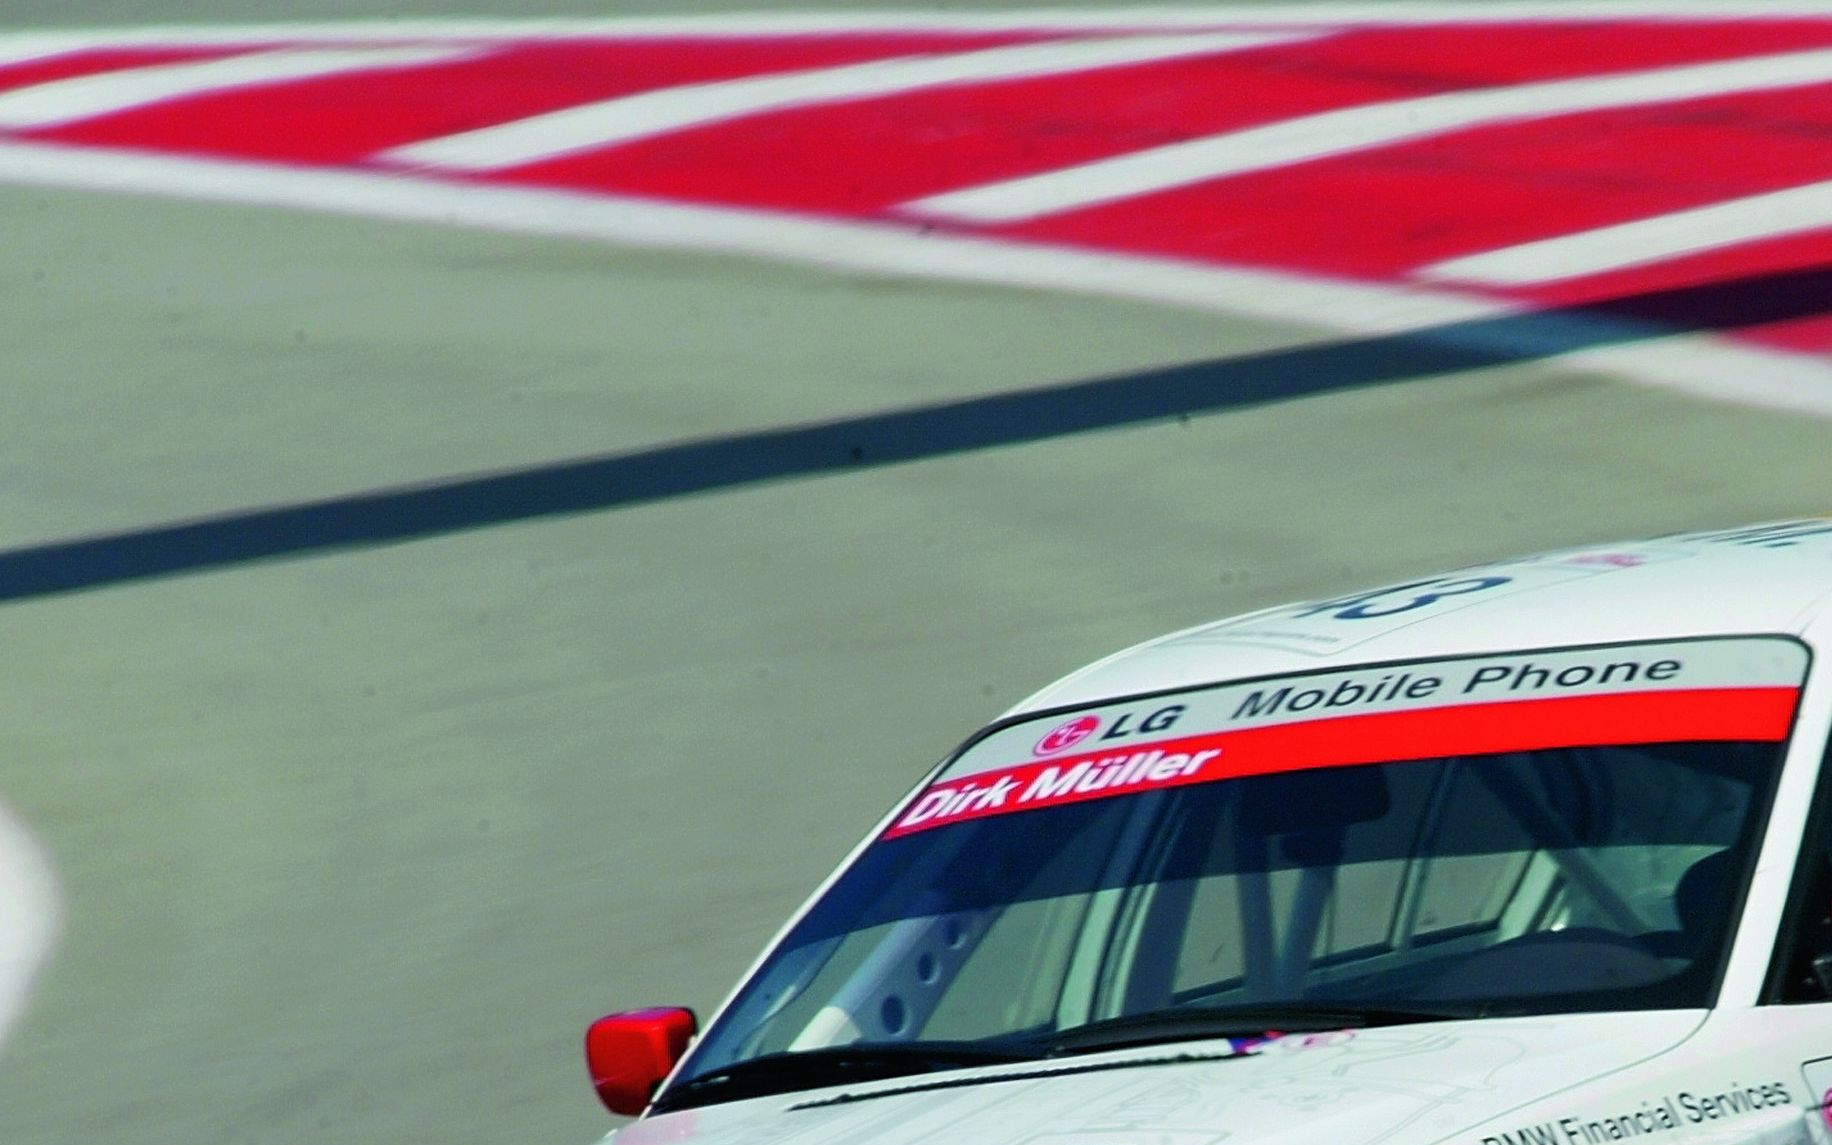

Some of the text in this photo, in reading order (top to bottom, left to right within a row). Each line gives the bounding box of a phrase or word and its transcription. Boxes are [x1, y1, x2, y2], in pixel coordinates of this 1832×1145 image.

[1100, 659, 1682, 740] LG Mobile Phone
[896, 748, 1222, 829] Dirk Müller
[1678, 1082, 1793, 1124] Services
